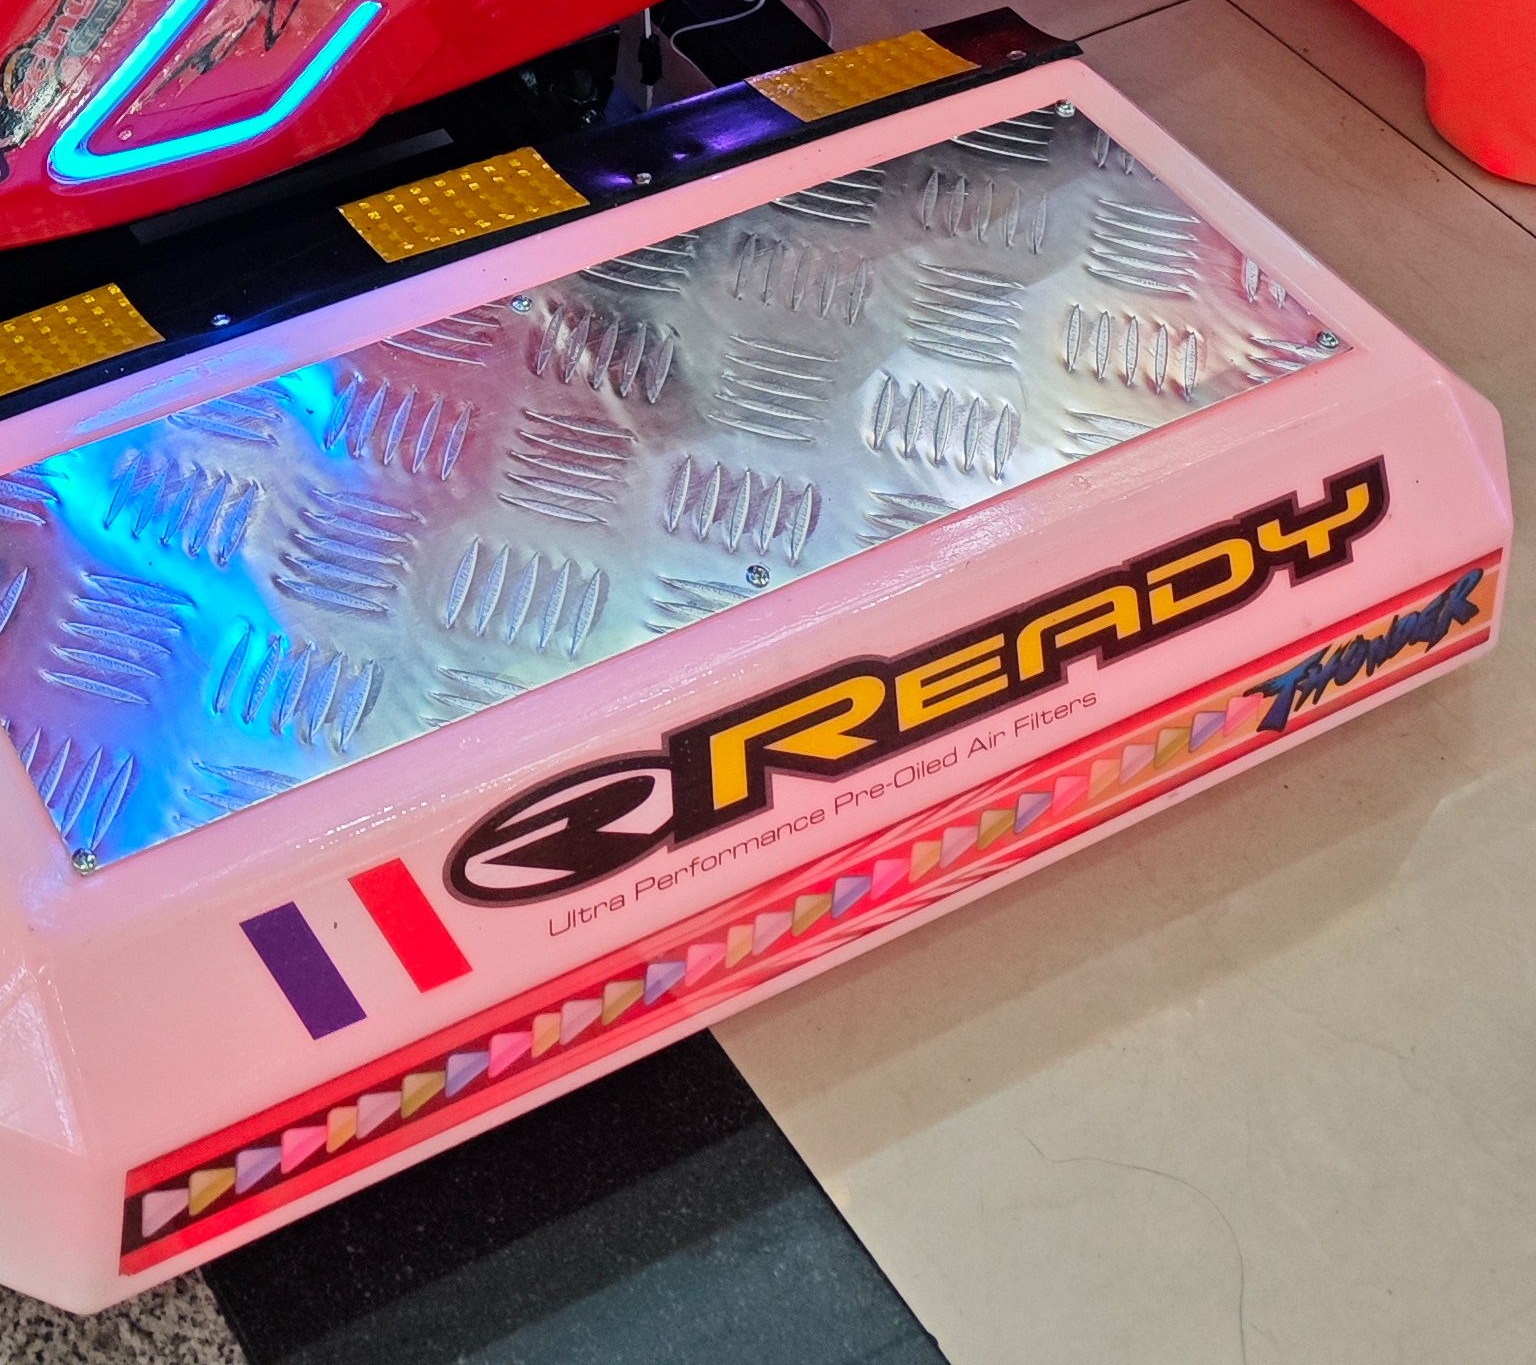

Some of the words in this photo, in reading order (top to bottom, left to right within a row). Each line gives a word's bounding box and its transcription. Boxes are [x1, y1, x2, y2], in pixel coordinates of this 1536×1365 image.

[707, 474, 1372, 811] READY
[547, 892, 626, 938] Ultra
[634, 808, 826, 901] Performance
[833, 747, 960, 816] Pre-Oiled
[966, 728, 1008, 757] Air
[1013, 690, 1099, 740] Filters
